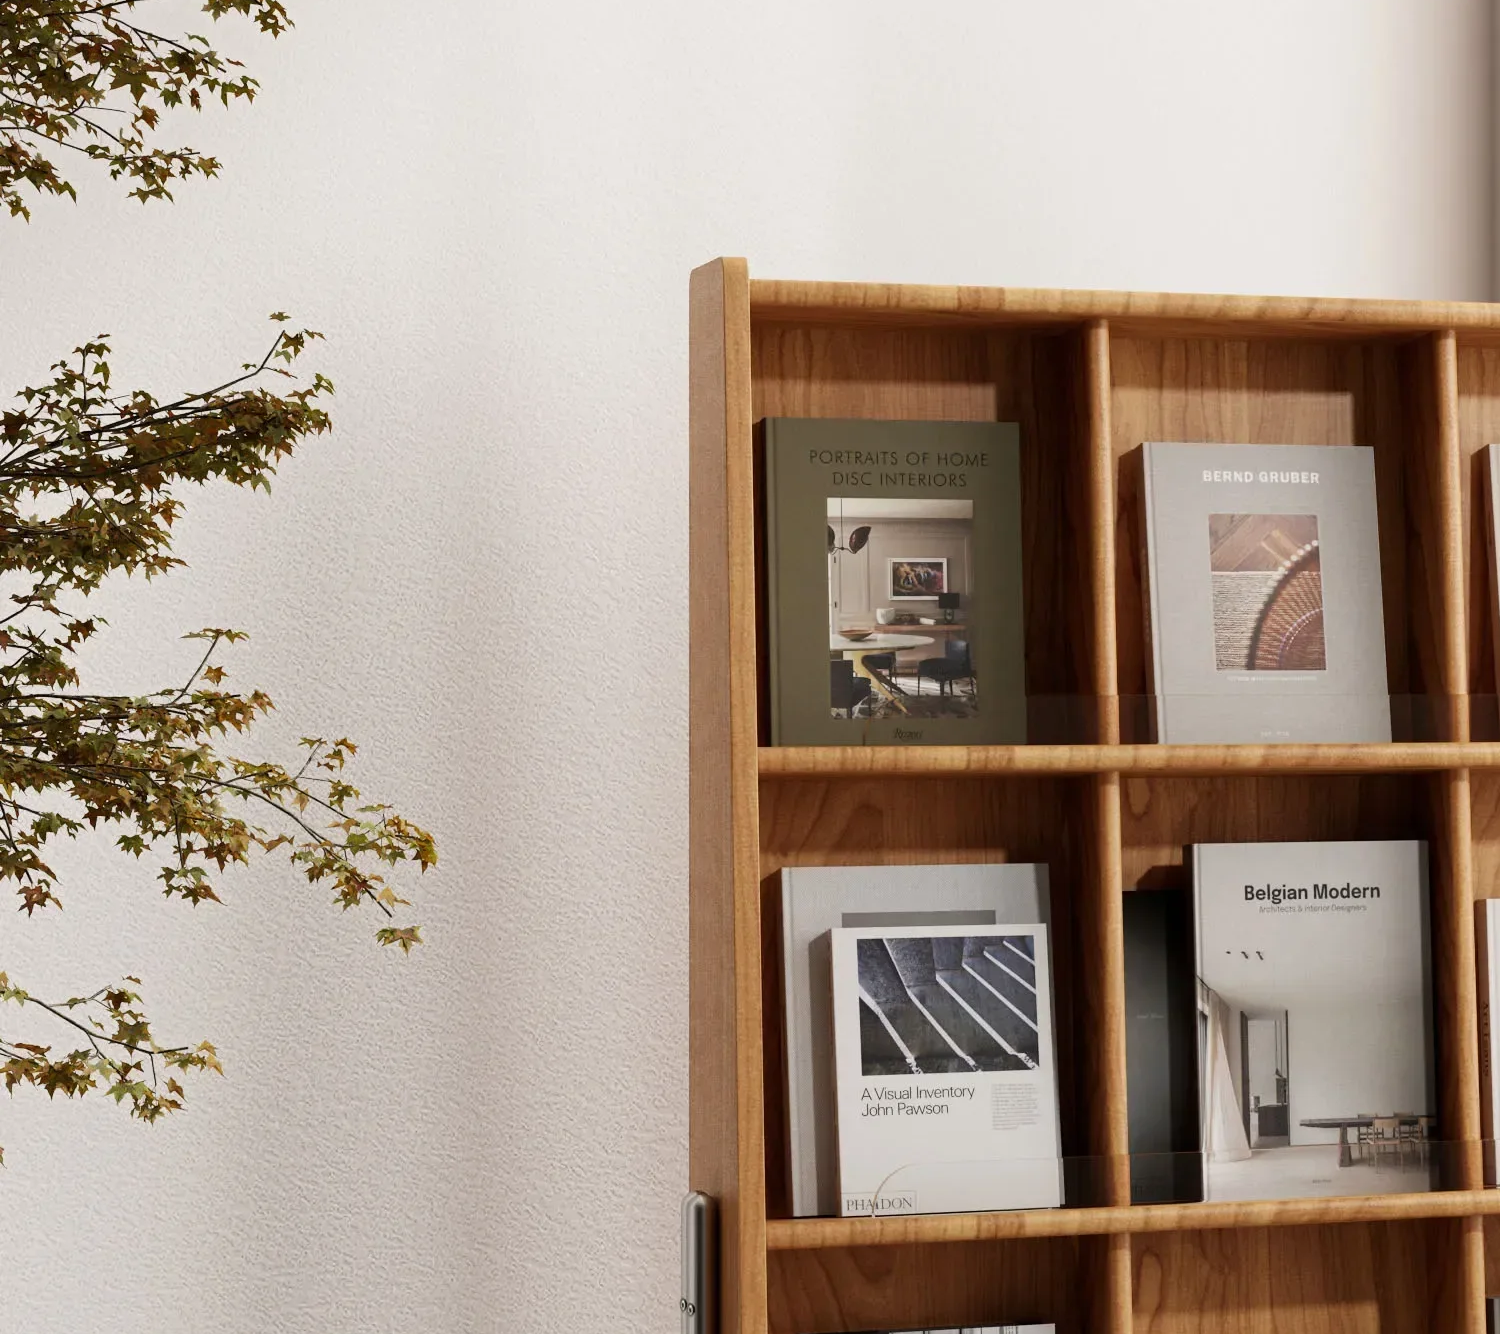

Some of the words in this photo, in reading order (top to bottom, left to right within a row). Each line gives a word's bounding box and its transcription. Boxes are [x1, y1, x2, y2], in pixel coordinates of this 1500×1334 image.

[809, 449, 898, 466] PORTRAITS
[906, 451, 930, 466] OF
[937, 452, 990, 467] HOME
[832, 471, 873, 487] DISC
[879, 472, 968, 488] INTERIORS
[1202, 469, 1254, 483] BERND
[1258, 470, 1320, 484] GRUBER
[1244, 883, 1308, 905] Belgian
[1313, 882, 1381, 899] Modern
[860, 1087, 873, 1101] A
[874, 1086, 912, 1100] Visual
[916, 1085, 976, 1100] Inventory
[861, 1102, 894, 1117] John
[897, 1102, 949, 1116] Pawson
